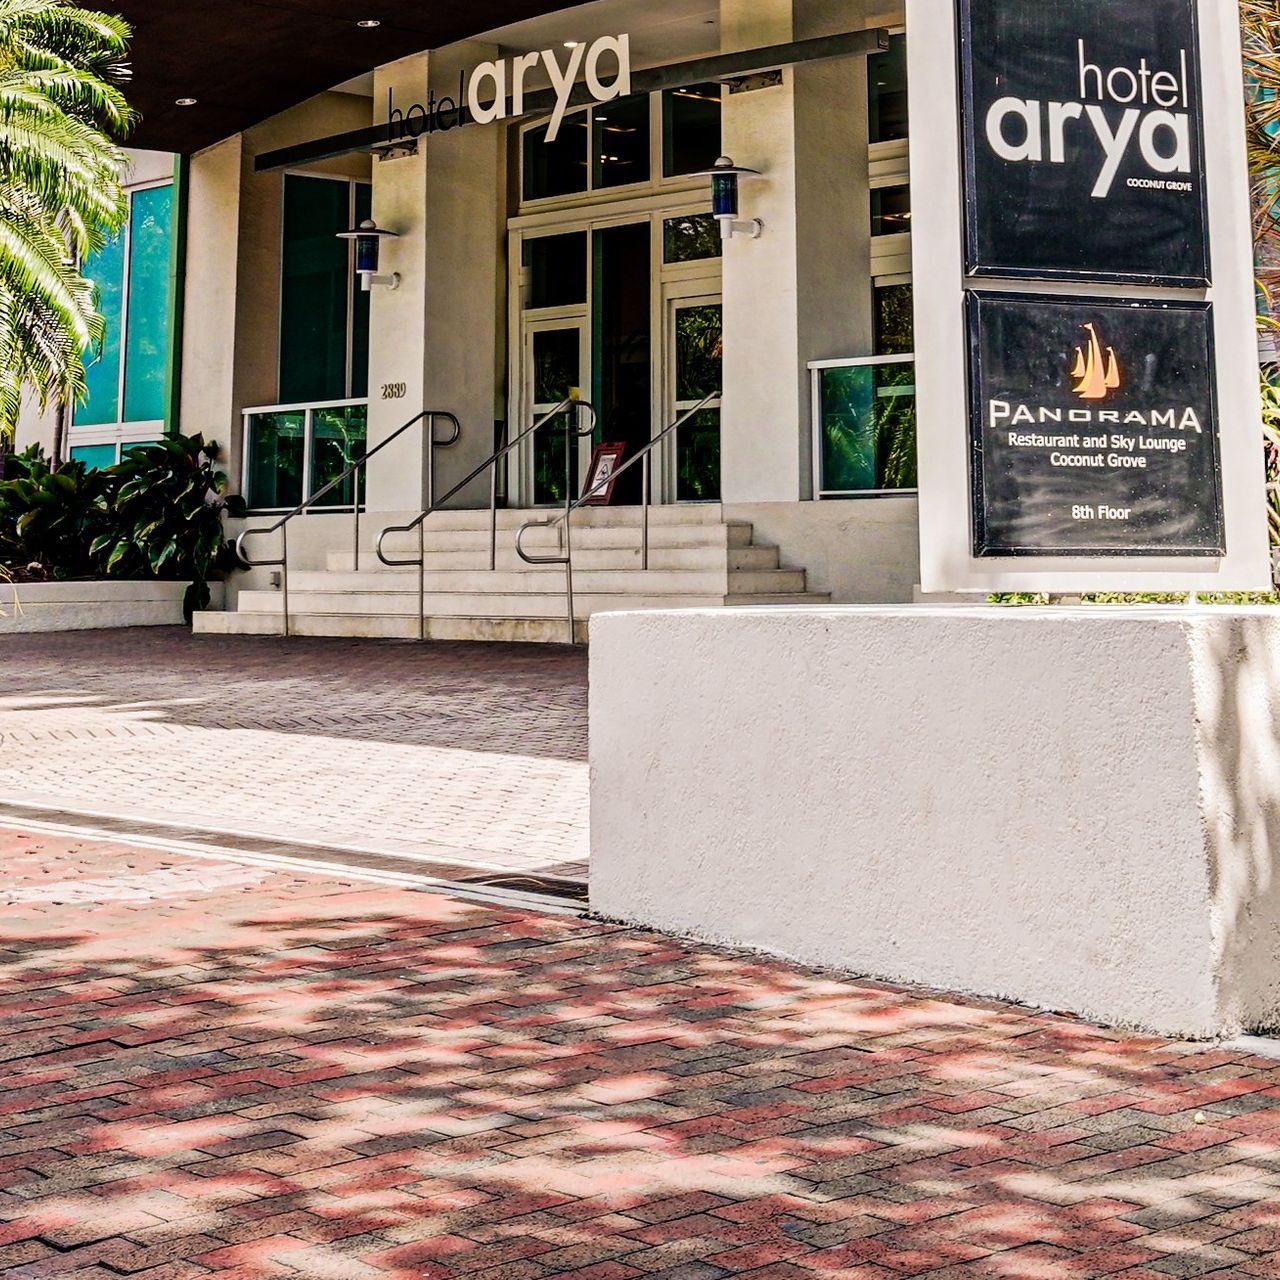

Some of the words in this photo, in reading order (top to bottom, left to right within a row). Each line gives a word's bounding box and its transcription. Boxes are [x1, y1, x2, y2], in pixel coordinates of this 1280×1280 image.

[1077, 38, 1189, 108] hotel
[388, 69, 465, 142] hotel
[467, 33, 631, 143] arya
[985, 96, 1192, 198] arya
[1126, 178, 1166, 190] COCONUT
[1165, 181, 1193, 192] GROVE
[989, 399, 1202, 434] PANORAMA
[1008, 432, 1080, 448] Restaurant
[1082, 434, 1108, 449] and
[1110, 435, 1136, 452] Sky
[1139, 436, 1187, 453] Lounge
[1050, 452, 1105, 467] Coconut
[1107, 454, 1147, 468] Grove
[1071, 505, 1095, 520] 8th
[1097, 506, 1132, 520] Floor
